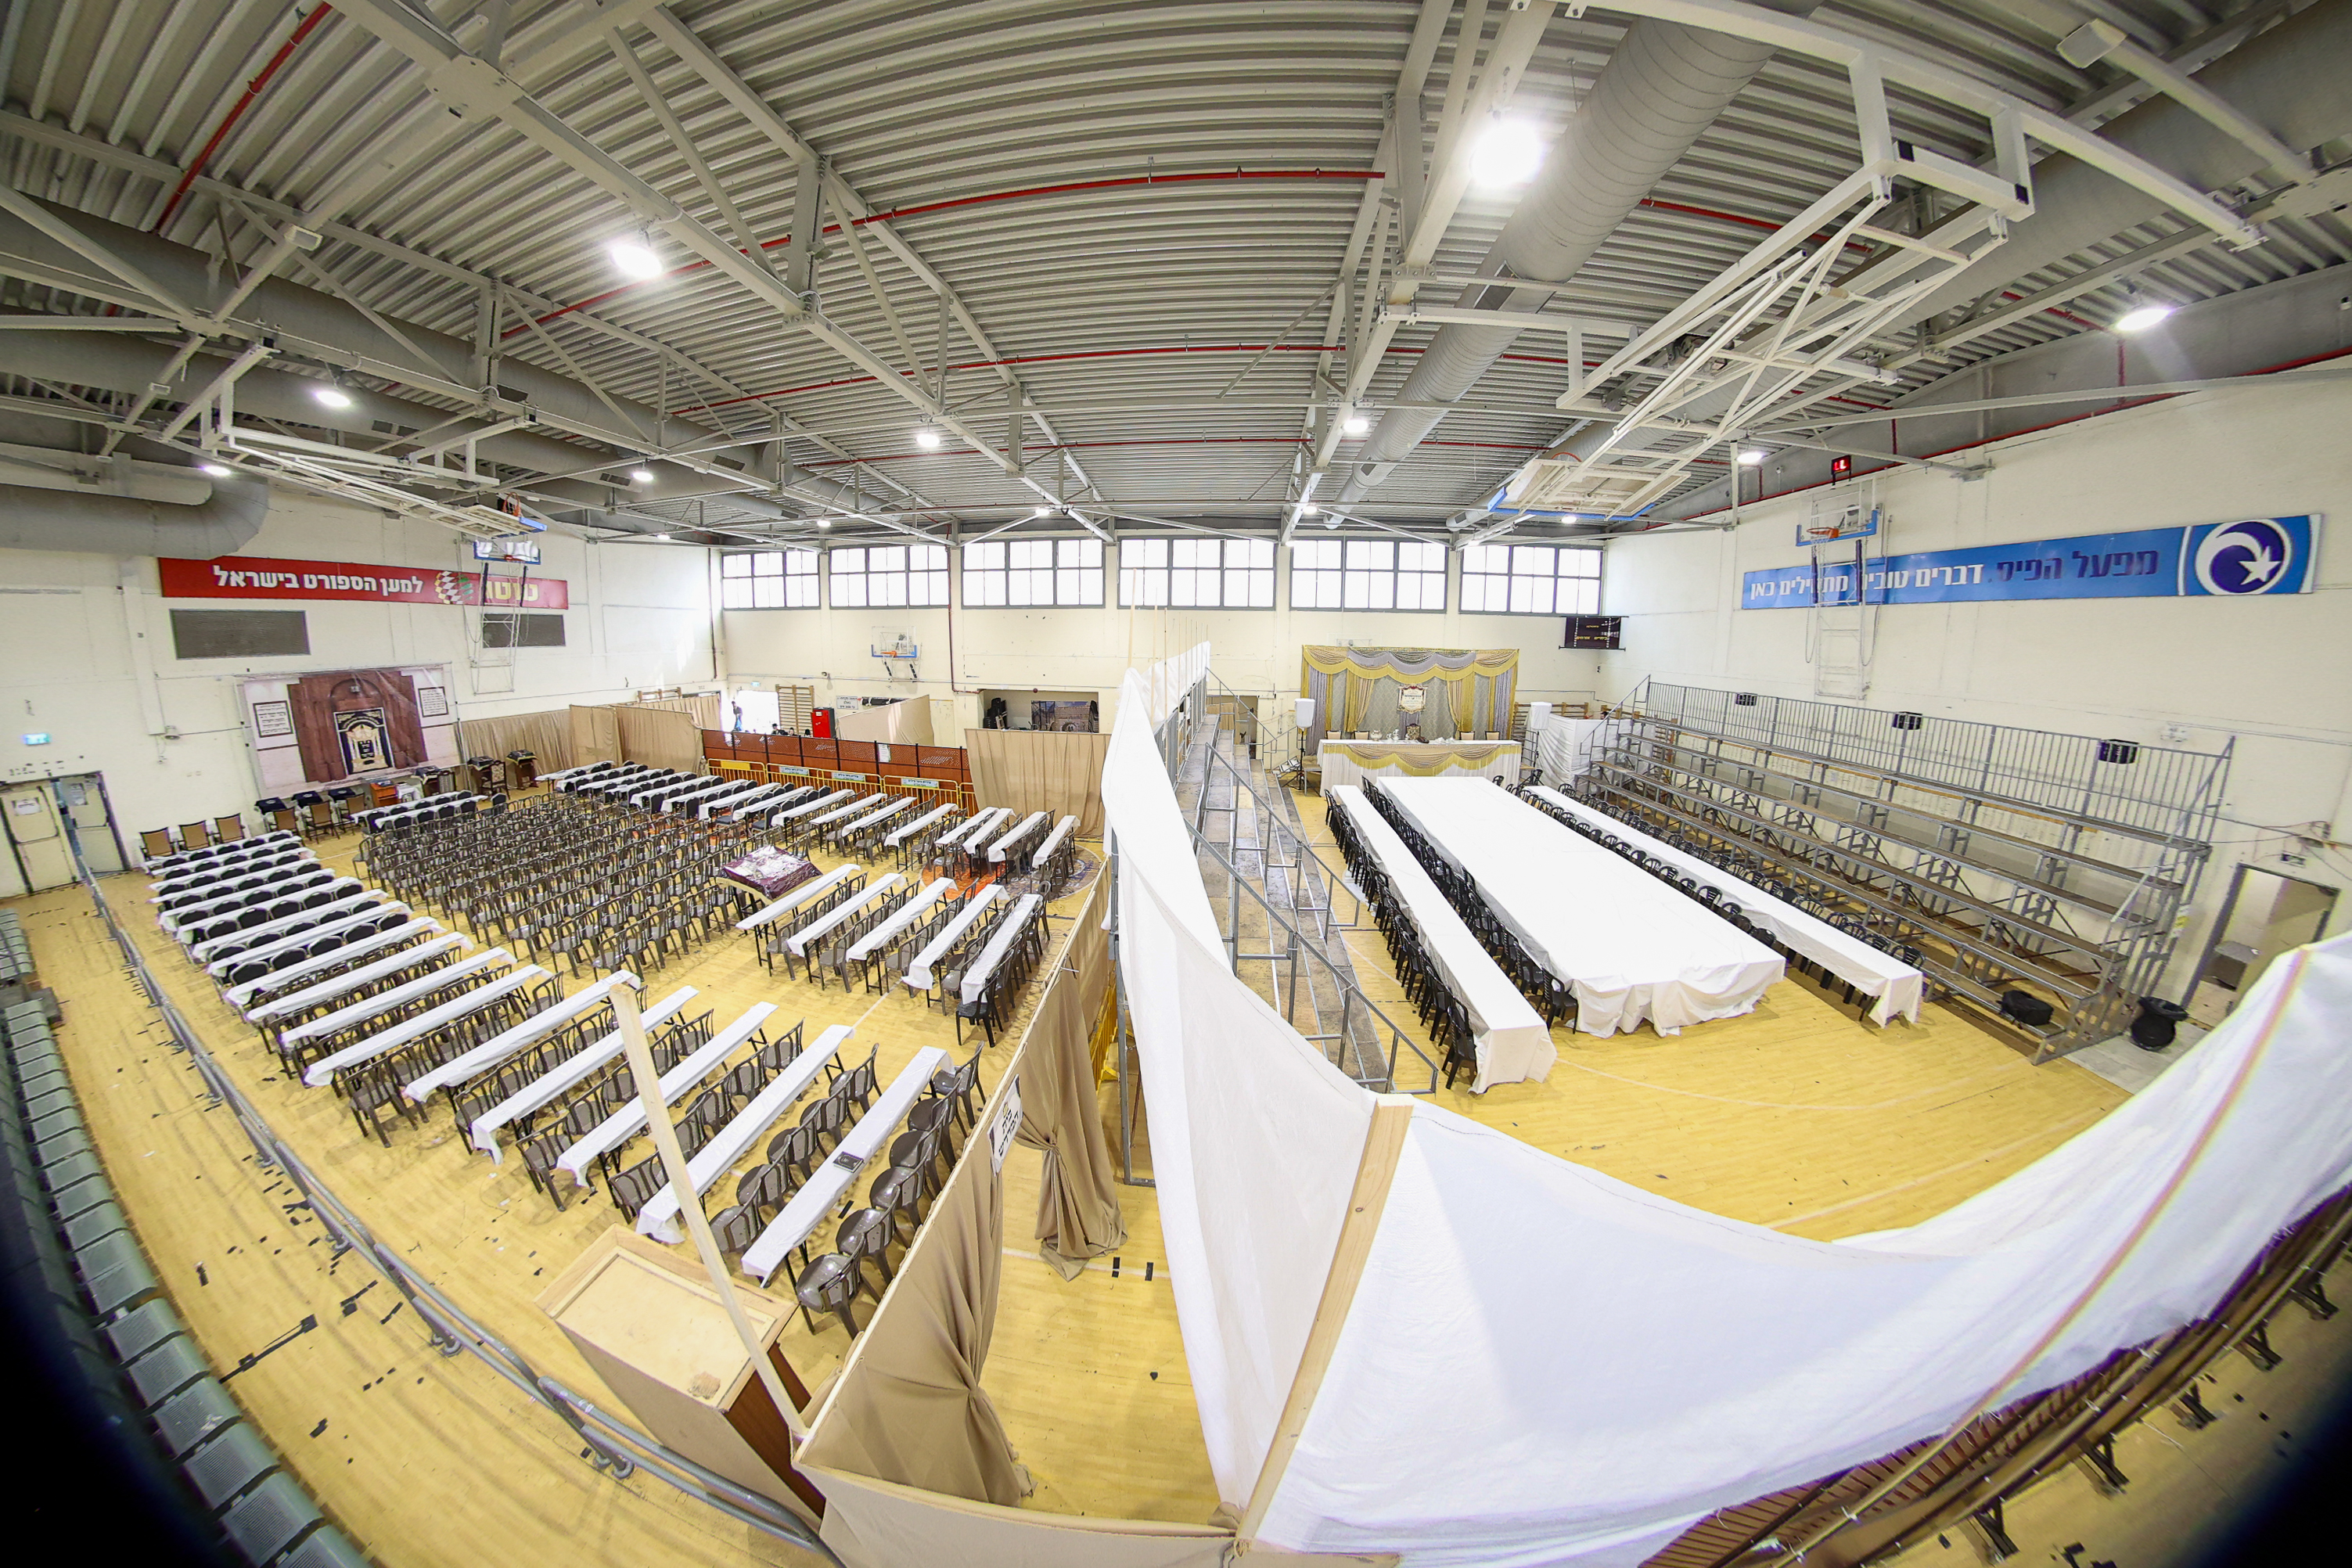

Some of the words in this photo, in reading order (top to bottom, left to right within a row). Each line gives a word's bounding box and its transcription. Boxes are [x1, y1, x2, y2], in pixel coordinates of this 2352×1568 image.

[2072, 550, 2158, 578] מפעל
[212, 565, 300, 588] בישראל
[304, 573, 377, 592] הספורט
[379, 576, 423, 596] למען
[1915, 564, 1984, 587] דברים
[1750, 581, 1775, 600] כאן
